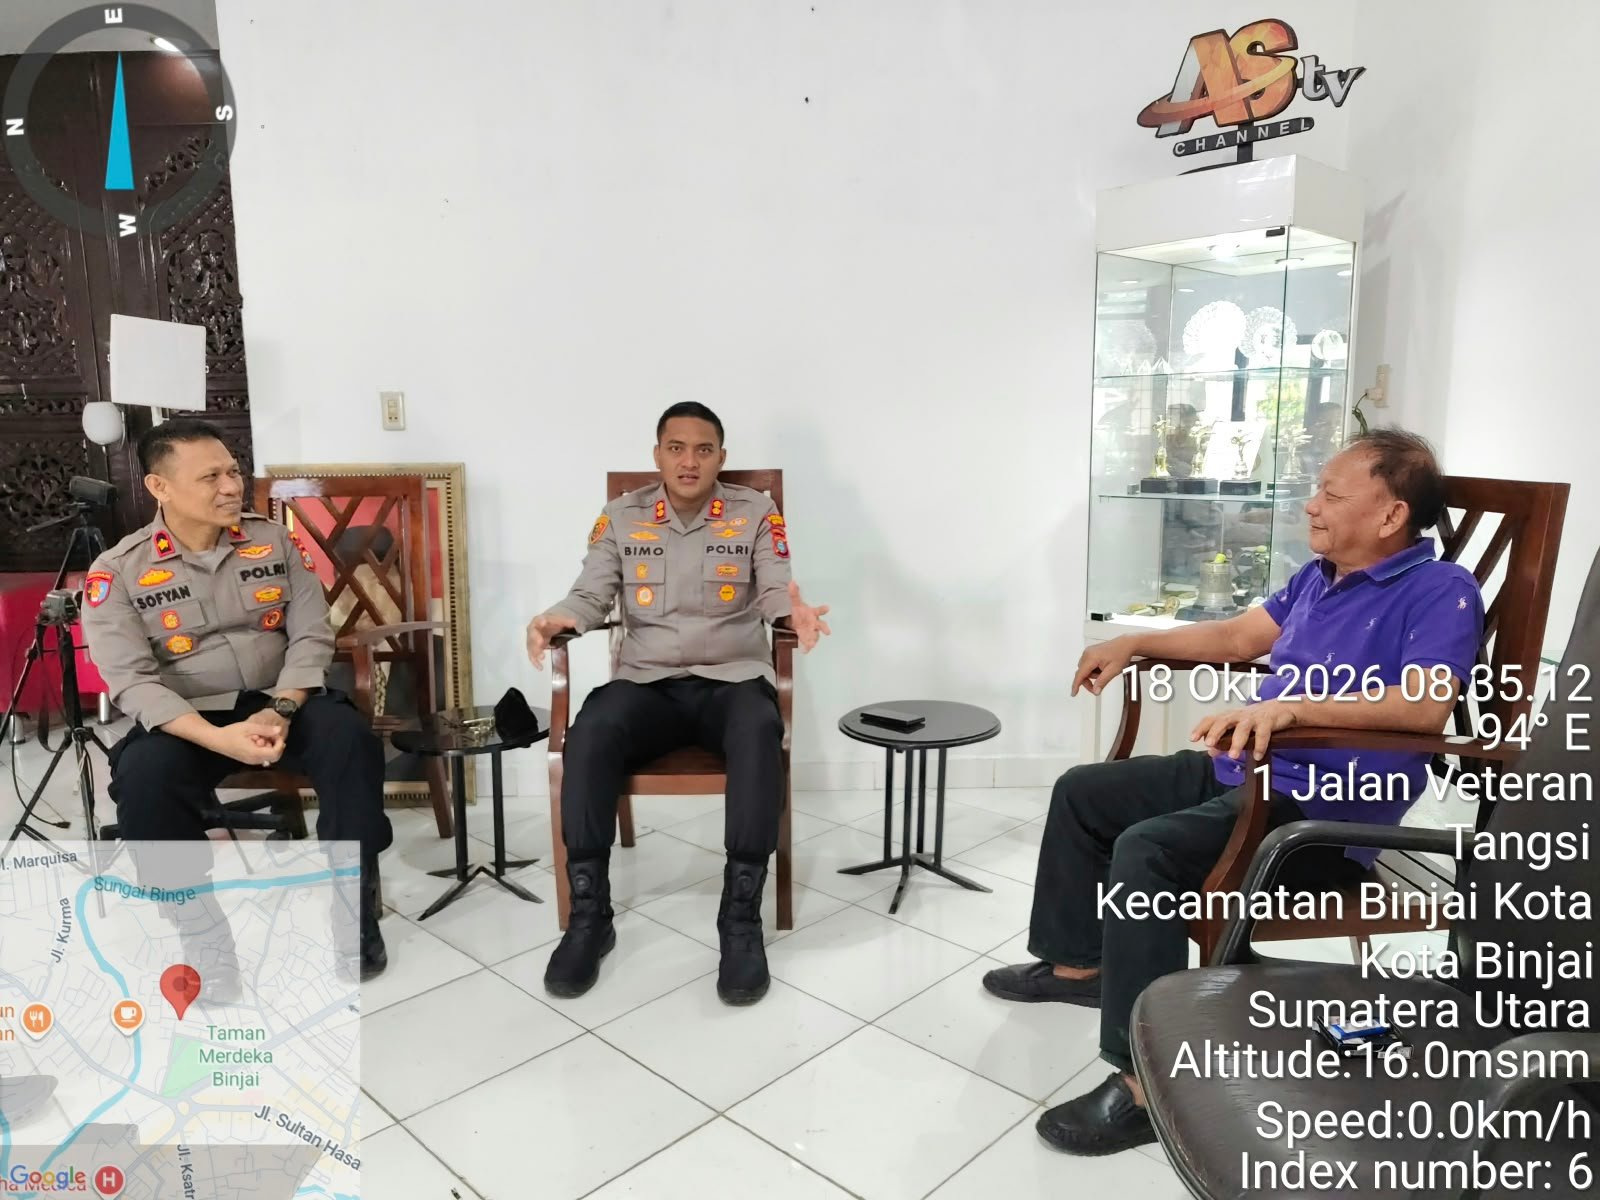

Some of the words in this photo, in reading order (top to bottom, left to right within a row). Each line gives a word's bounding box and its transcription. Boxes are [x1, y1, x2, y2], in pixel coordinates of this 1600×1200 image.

[1174, 118, 1312, 155] CHANNEL
[624, 546, 664, 556] BIMO
[706, 544, 749, 555] POLRI
[240, 563, 286, 582] POLRI
[137, 585, 191, 610] SOFYAN
